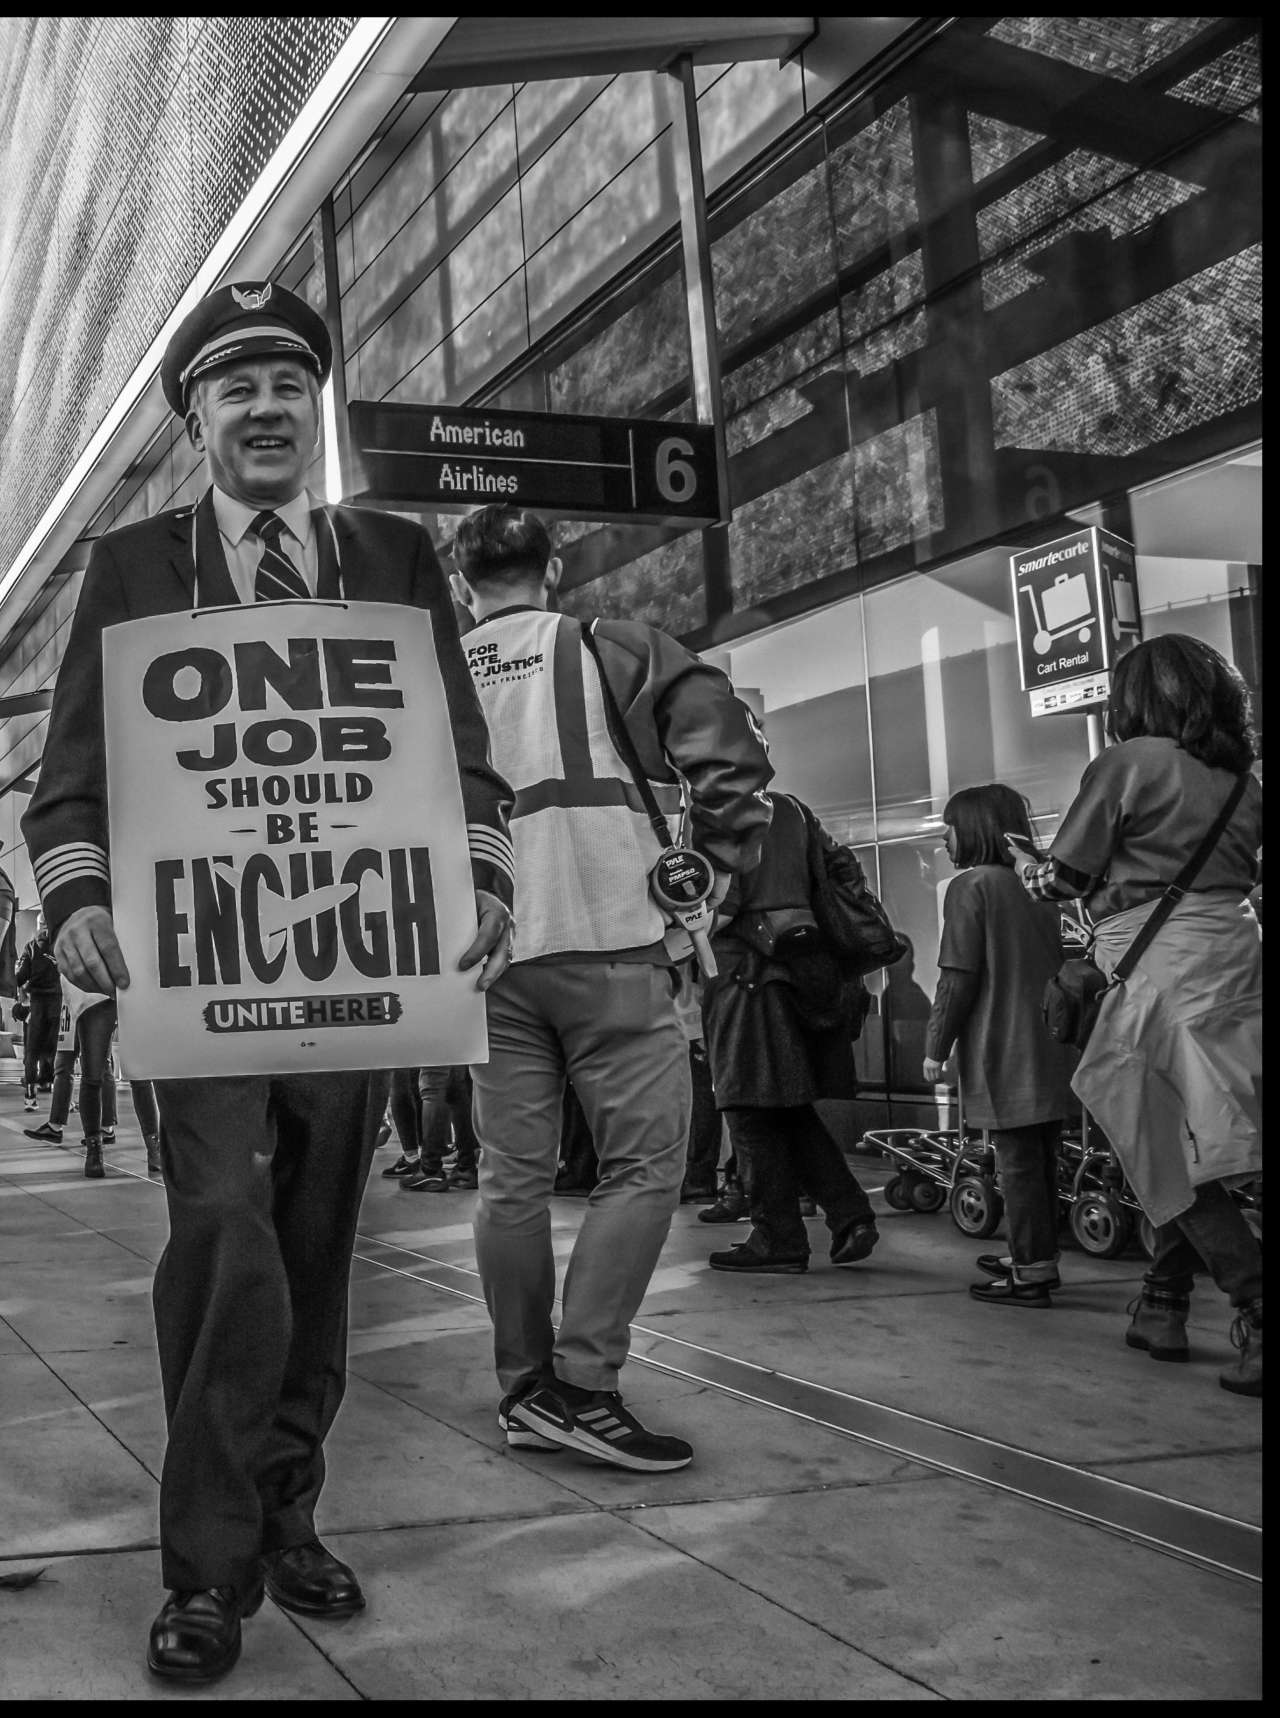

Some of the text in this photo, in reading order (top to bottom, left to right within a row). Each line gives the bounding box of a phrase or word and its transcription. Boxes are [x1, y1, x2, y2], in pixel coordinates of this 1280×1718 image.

[430, 416, 524, 447] American
[439, 463, 518, 493] Airlines
[655, 436, 697, 502] 6
[468, 643, 499, 658] FOR
[483, 653, 544, 678] JUSTICE
[1037, 651, 1089, 675] Cart Rental
[142, 637, 406, 723] ONE
[175, 716, 392, 771] JOB
[205, 772, 373, 810] SHOULD
[266, 811, 319, 845] BE
[666, 855, 684, 867] PYLE
[154, 846, 441, 989] ENOUGH
[685, 911, 703, 923] PYLE
